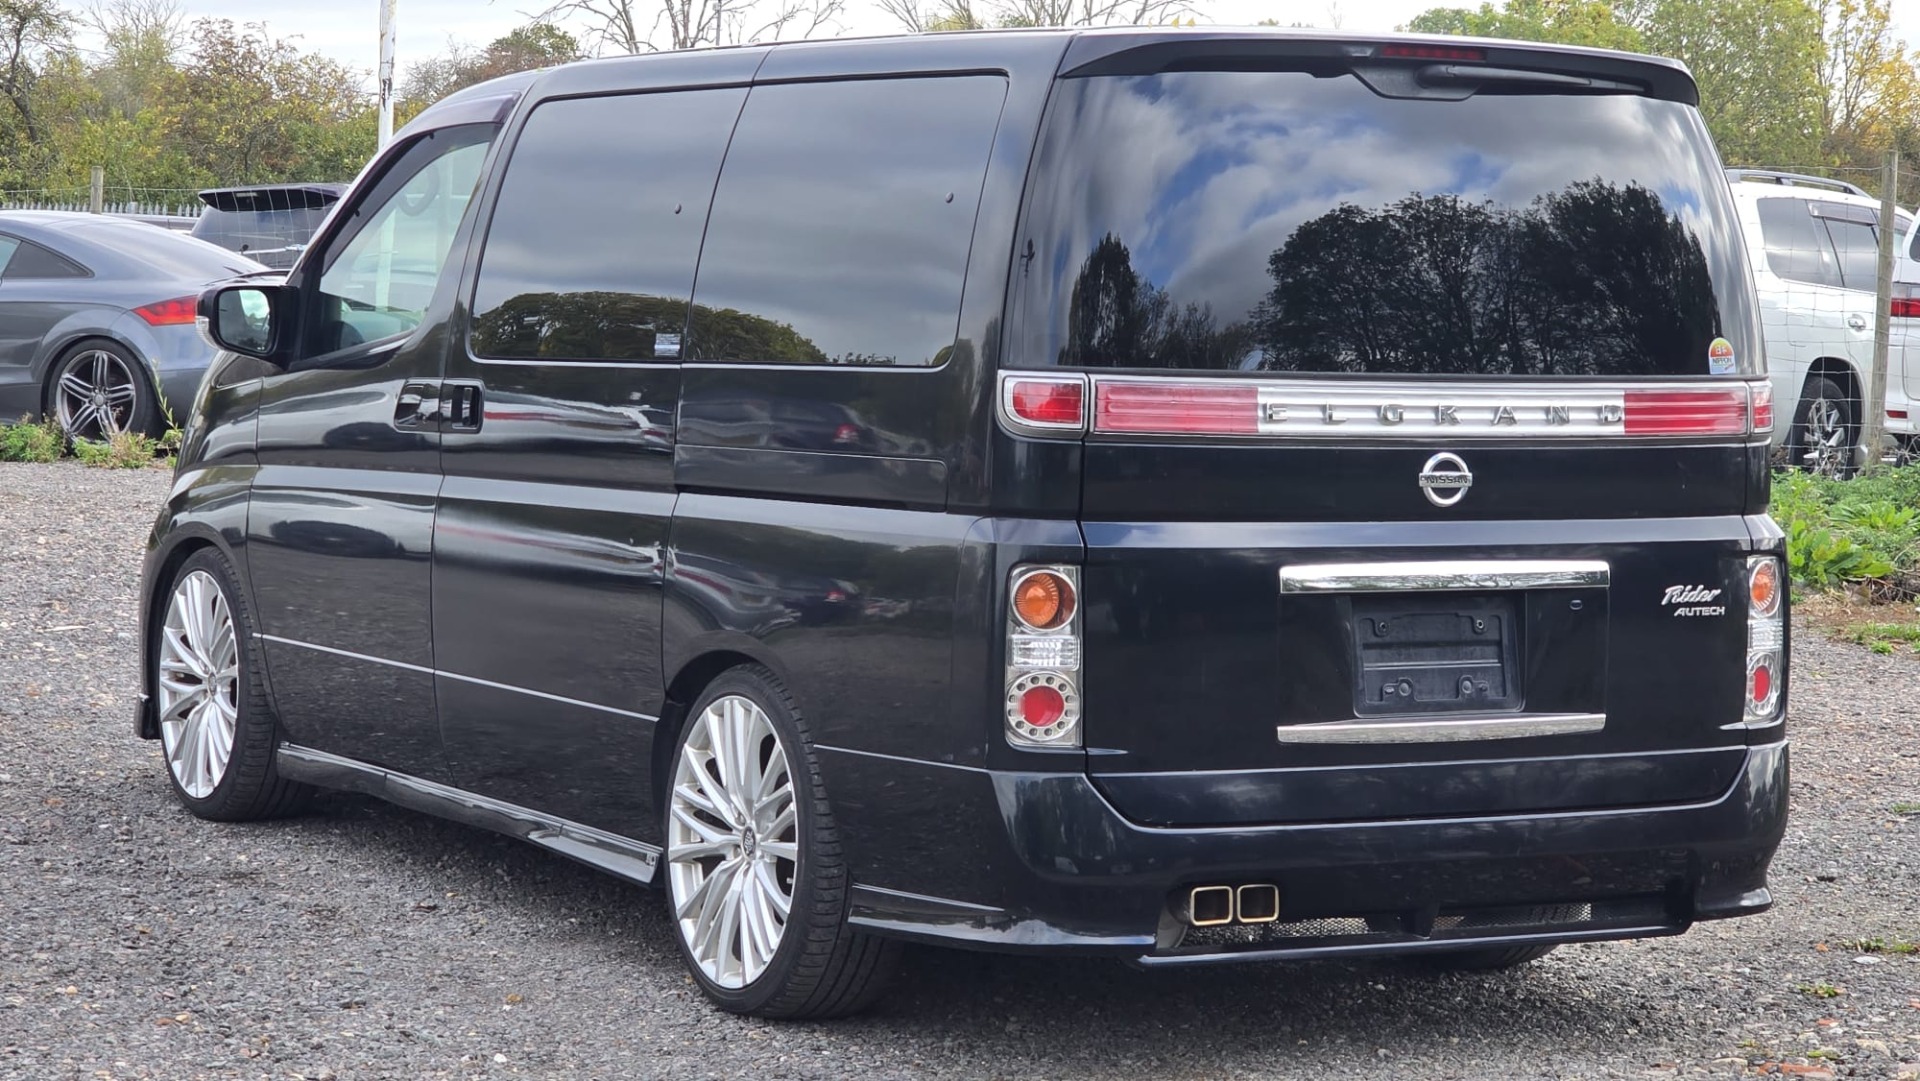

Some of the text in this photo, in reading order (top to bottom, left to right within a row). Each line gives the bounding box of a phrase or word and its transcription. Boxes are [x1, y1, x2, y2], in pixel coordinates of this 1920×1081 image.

[1426, 474, 1469, 484] NISSAN
[1661, 584, 1721, 605] Rider
[1674, 606, 1725, 617] AUTECH
